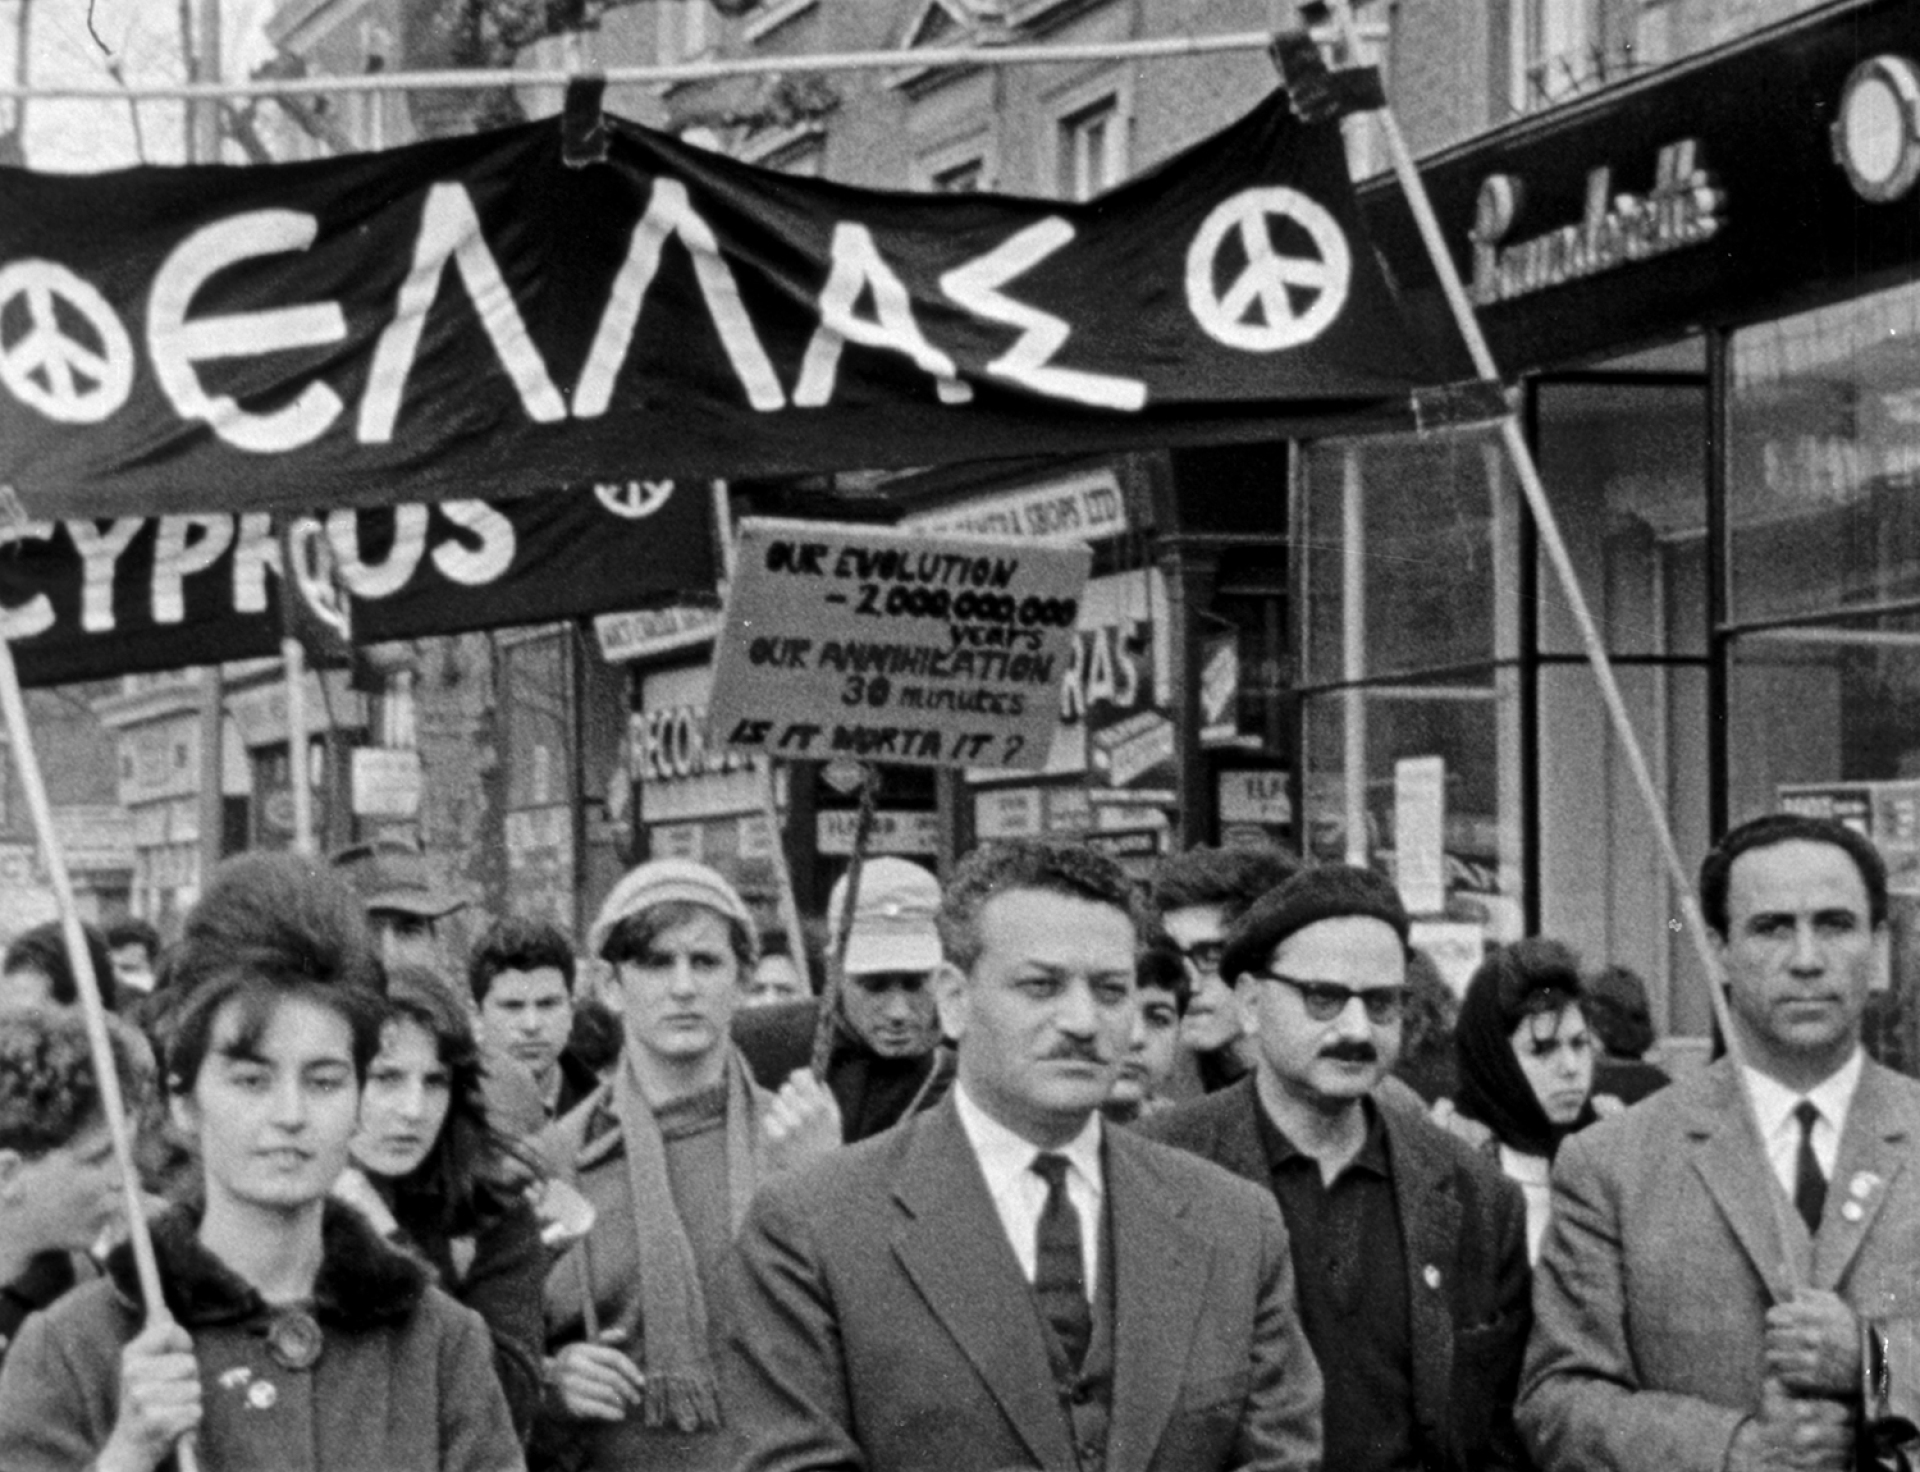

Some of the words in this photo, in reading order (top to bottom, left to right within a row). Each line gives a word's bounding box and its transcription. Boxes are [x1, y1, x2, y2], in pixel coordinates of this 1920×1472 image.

[147, 181, 1147, 454] ΕΛΛΑΣ
[766, 541, 829, 576] OUR
[834, 546, 1018, 588] EVOLUTION
[749, 636, 812, 668] OUR
[841, 675, 891, 707] 30
[728, 717, 774, 745] IS
[778, 722, 821, 751] IT
[951, 732, 995, 760] IT
